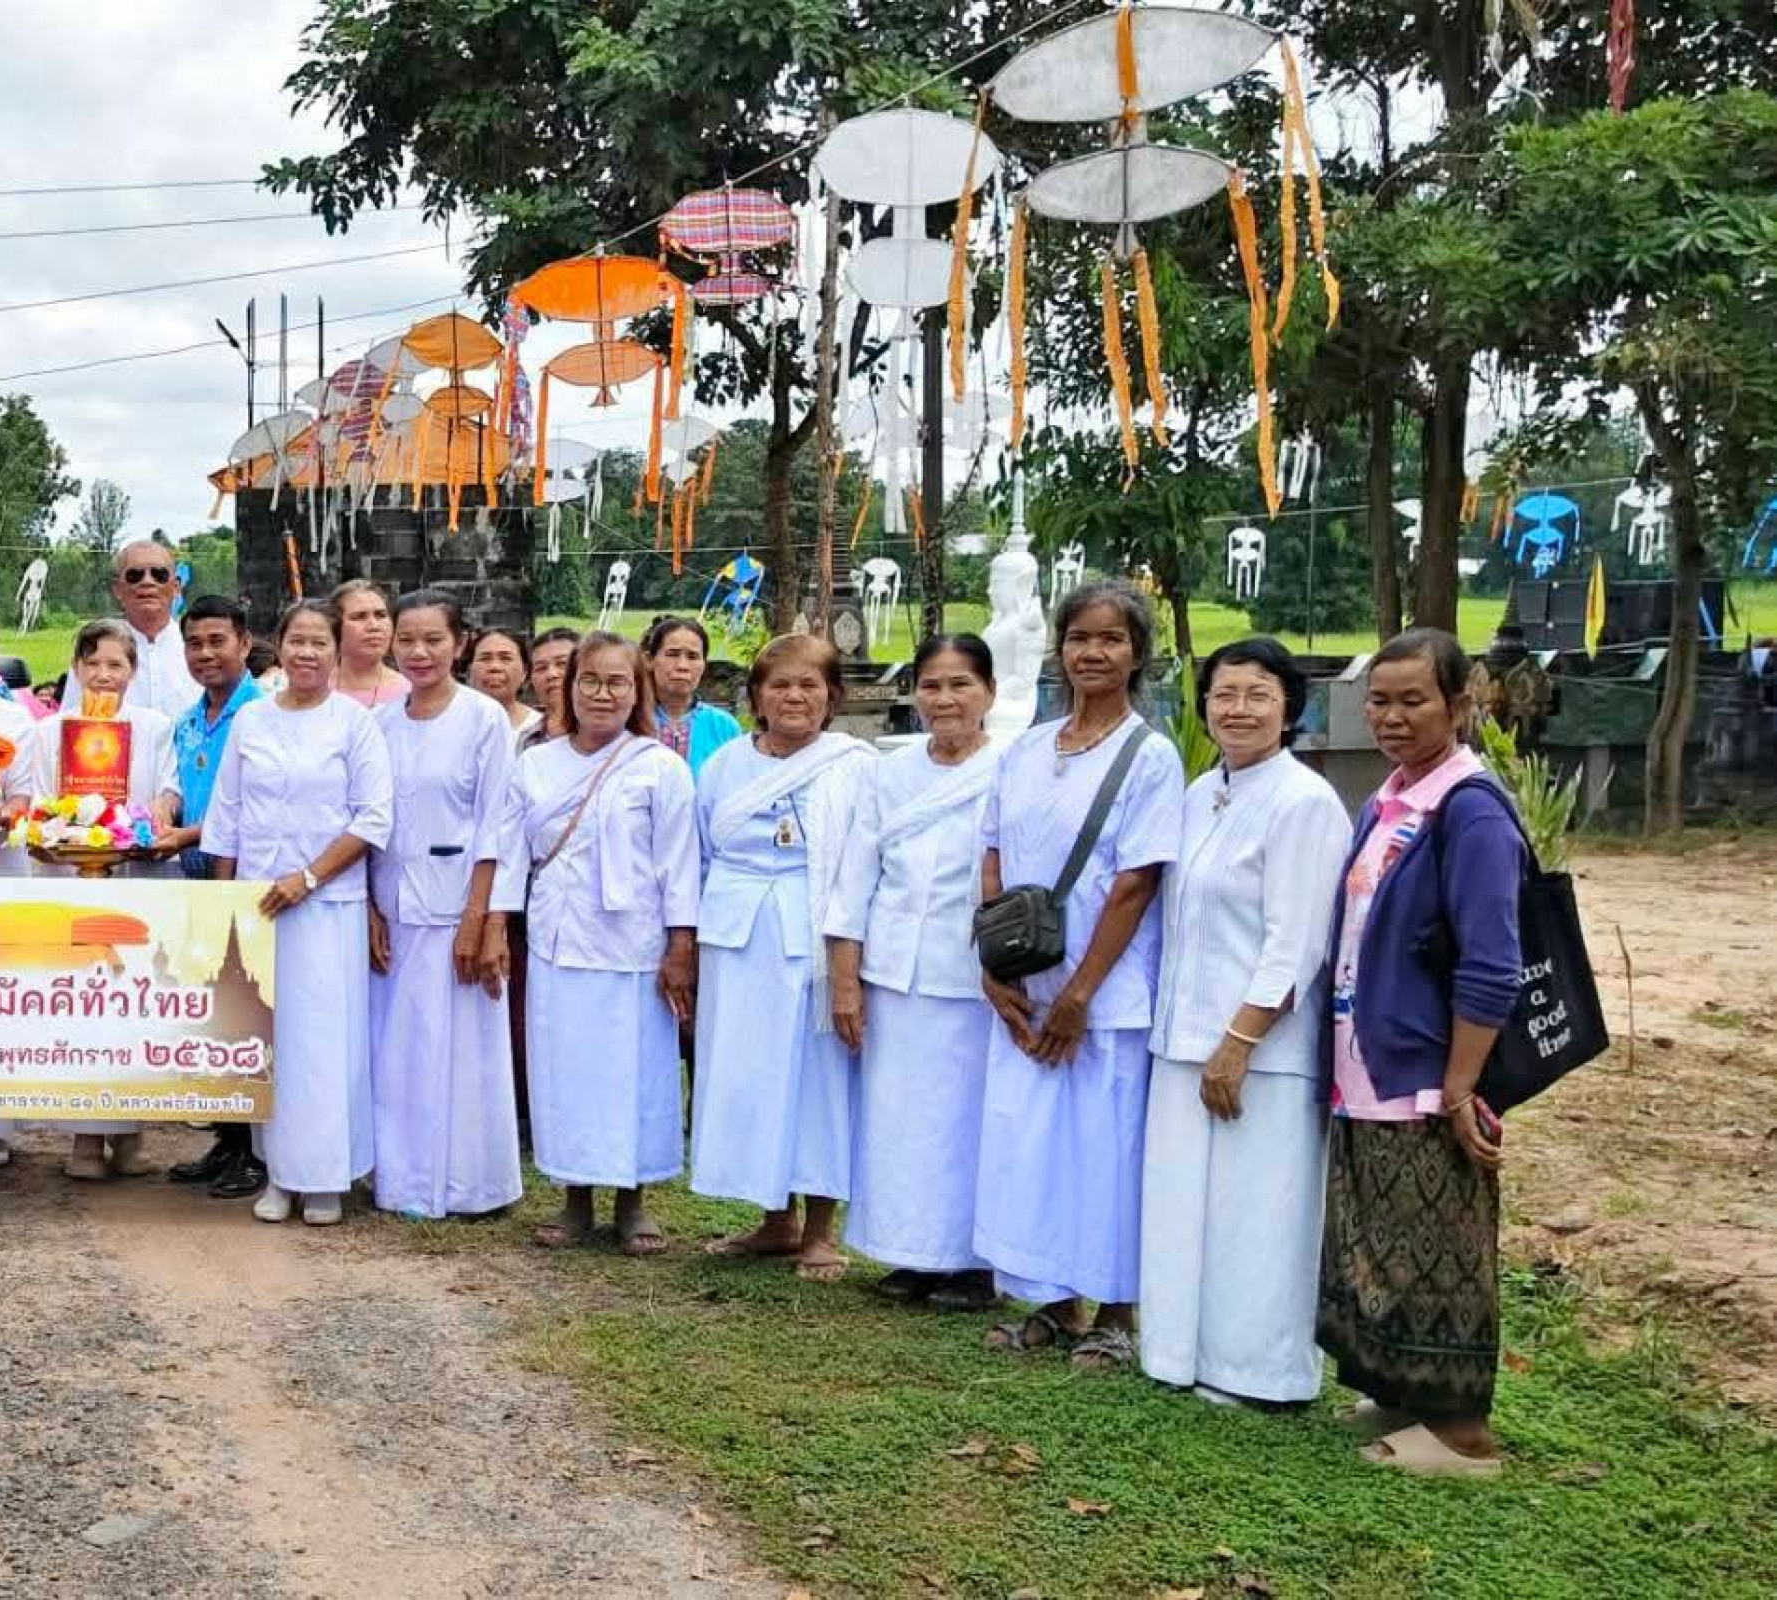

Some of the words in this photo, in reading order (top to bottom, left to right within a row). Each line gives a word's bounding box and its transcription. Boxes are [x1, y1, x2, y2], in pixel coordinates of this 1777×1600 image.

[1530, 989, 1548, 1006] a
[1527, 999, 1568, 1039] good
[144, 1039, 259, 1068] ๒๕๖๘
